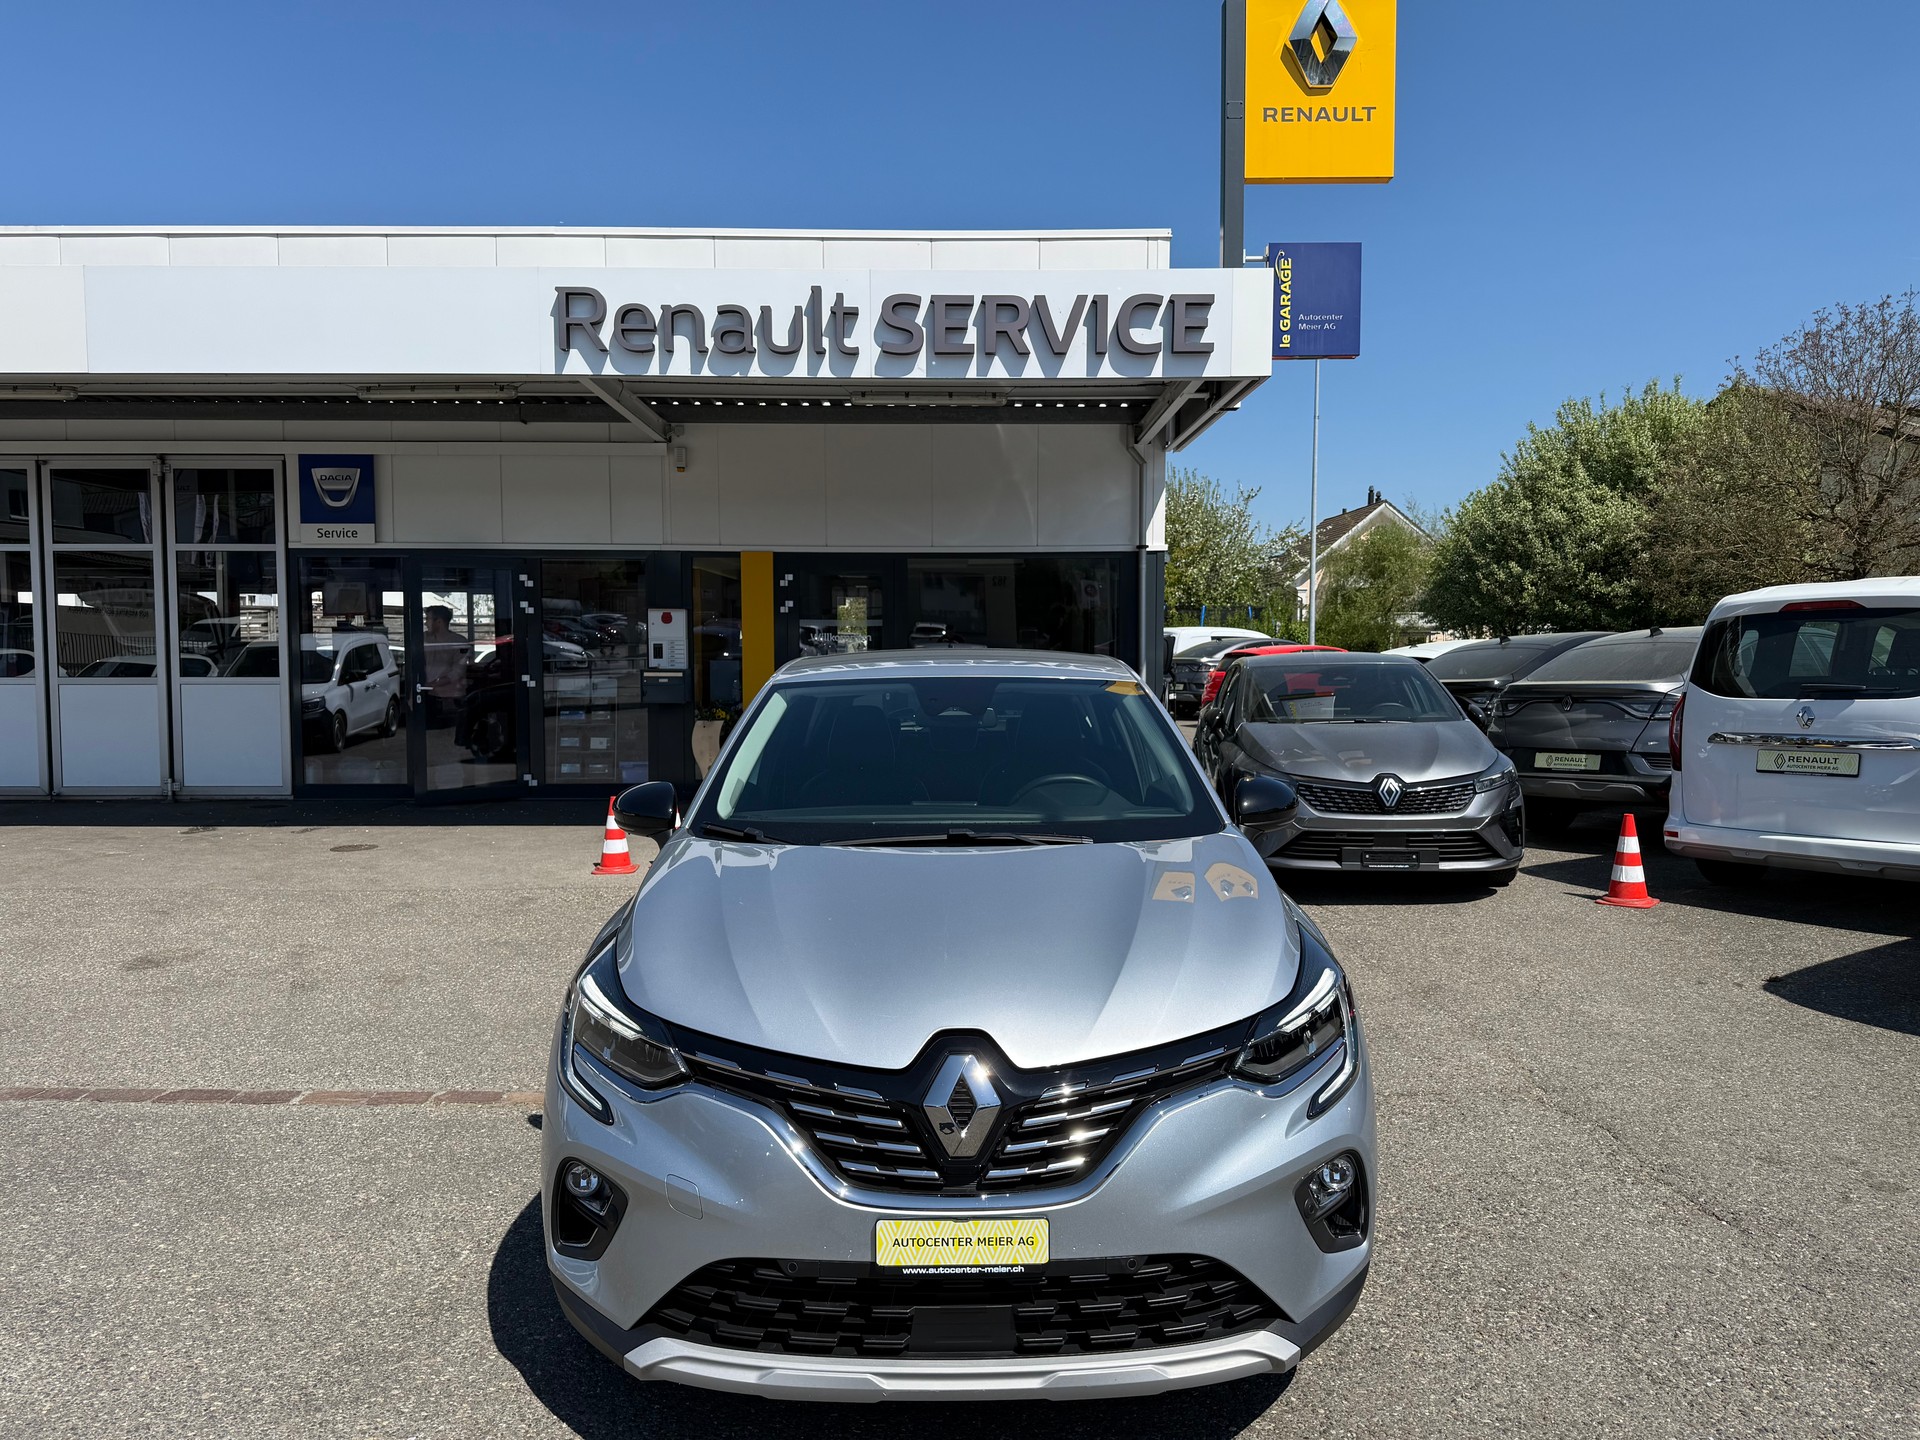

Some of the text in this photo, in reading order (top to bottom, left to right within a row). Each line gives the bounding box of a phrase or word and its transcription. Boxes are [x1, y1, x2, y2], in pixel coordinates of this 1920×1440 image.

[1263, 106, 1377, 122] RENAULT
[1279, 258, 1292, 348] le GARAGE
[554, 285, 1215, 356] Renault SERVICE
[1298, 313, 1344, 321] Autocenter
[1323, 322, 1336, 330] AG
[316, 527, 358, 539] Service
[1787, 755, 1840, 765] RENAULT
[892, 1236, 1035, 1248] AUTOCENTER MEIER AG
[902, 1265, 1025, 1275] www.autocenter-meier.ch
